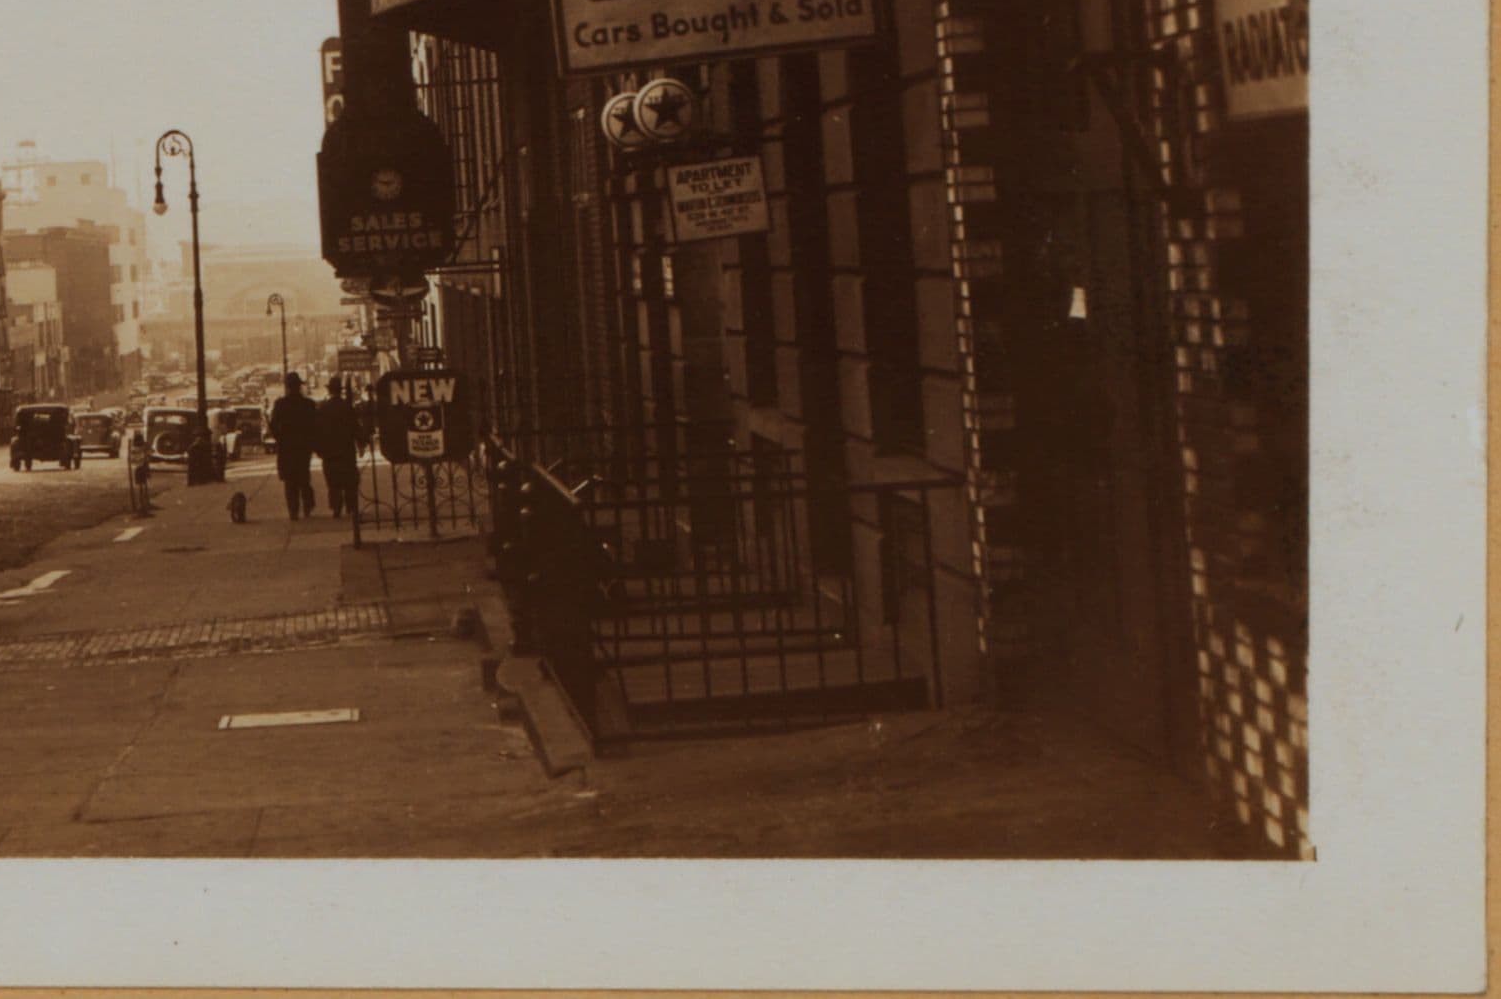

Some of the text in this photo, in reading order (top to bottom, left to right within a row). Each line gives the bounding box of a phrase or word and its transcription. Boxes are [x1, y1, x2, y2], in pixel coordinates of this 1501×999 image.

[574, 19, 642, 48] Cars
[651, 4, 759, 43] Bought
[769, 4, 790, 26] &
[350, 212, 423, 233] SALES
[338, 229, 443, 253] SERVICE
[390, 377, 456, 403] NEW
